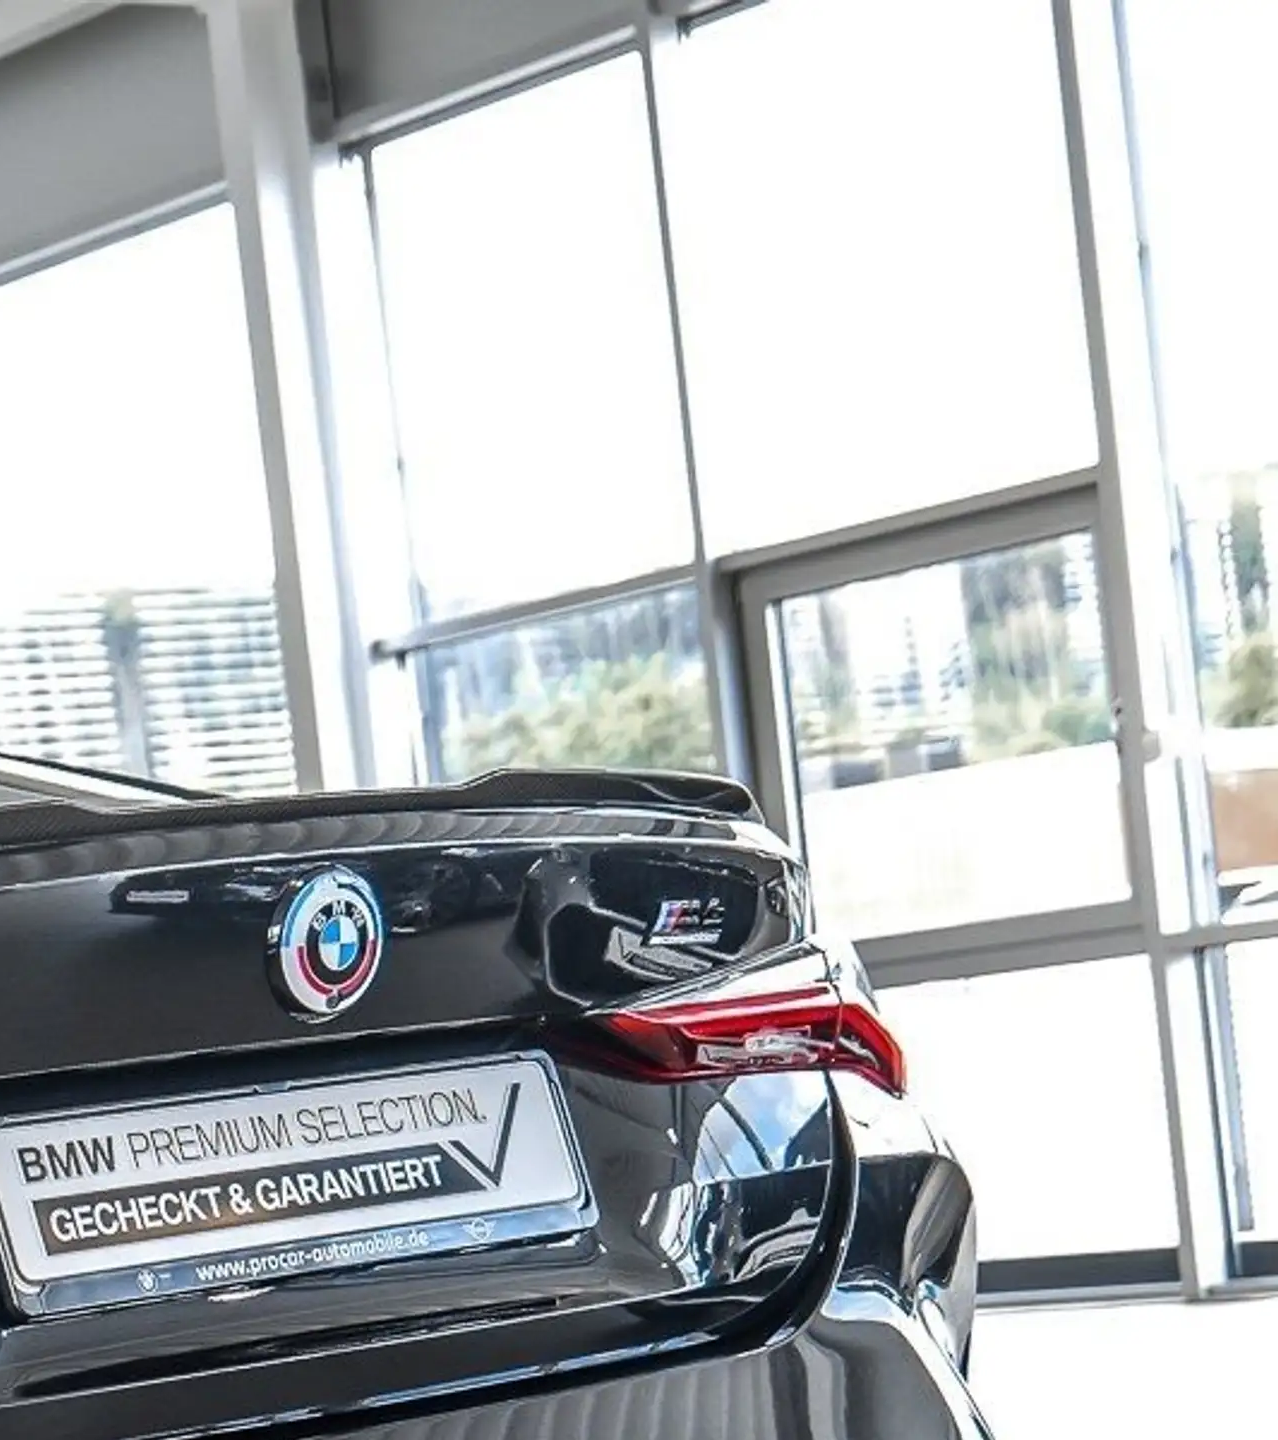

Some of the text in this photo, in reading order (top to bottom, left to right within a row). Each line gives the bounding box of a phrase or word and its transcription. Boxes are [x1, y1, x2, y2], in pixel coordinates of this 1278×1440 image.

[17, 1135, 116, 1184] BMW
[127, 1112, 293, 1170] PREMIUM
[49, 1154, 442, 1242] GECHECKT & GARANTIERT
[195, 1228, 430, 1282] www.procar-automobile.de
